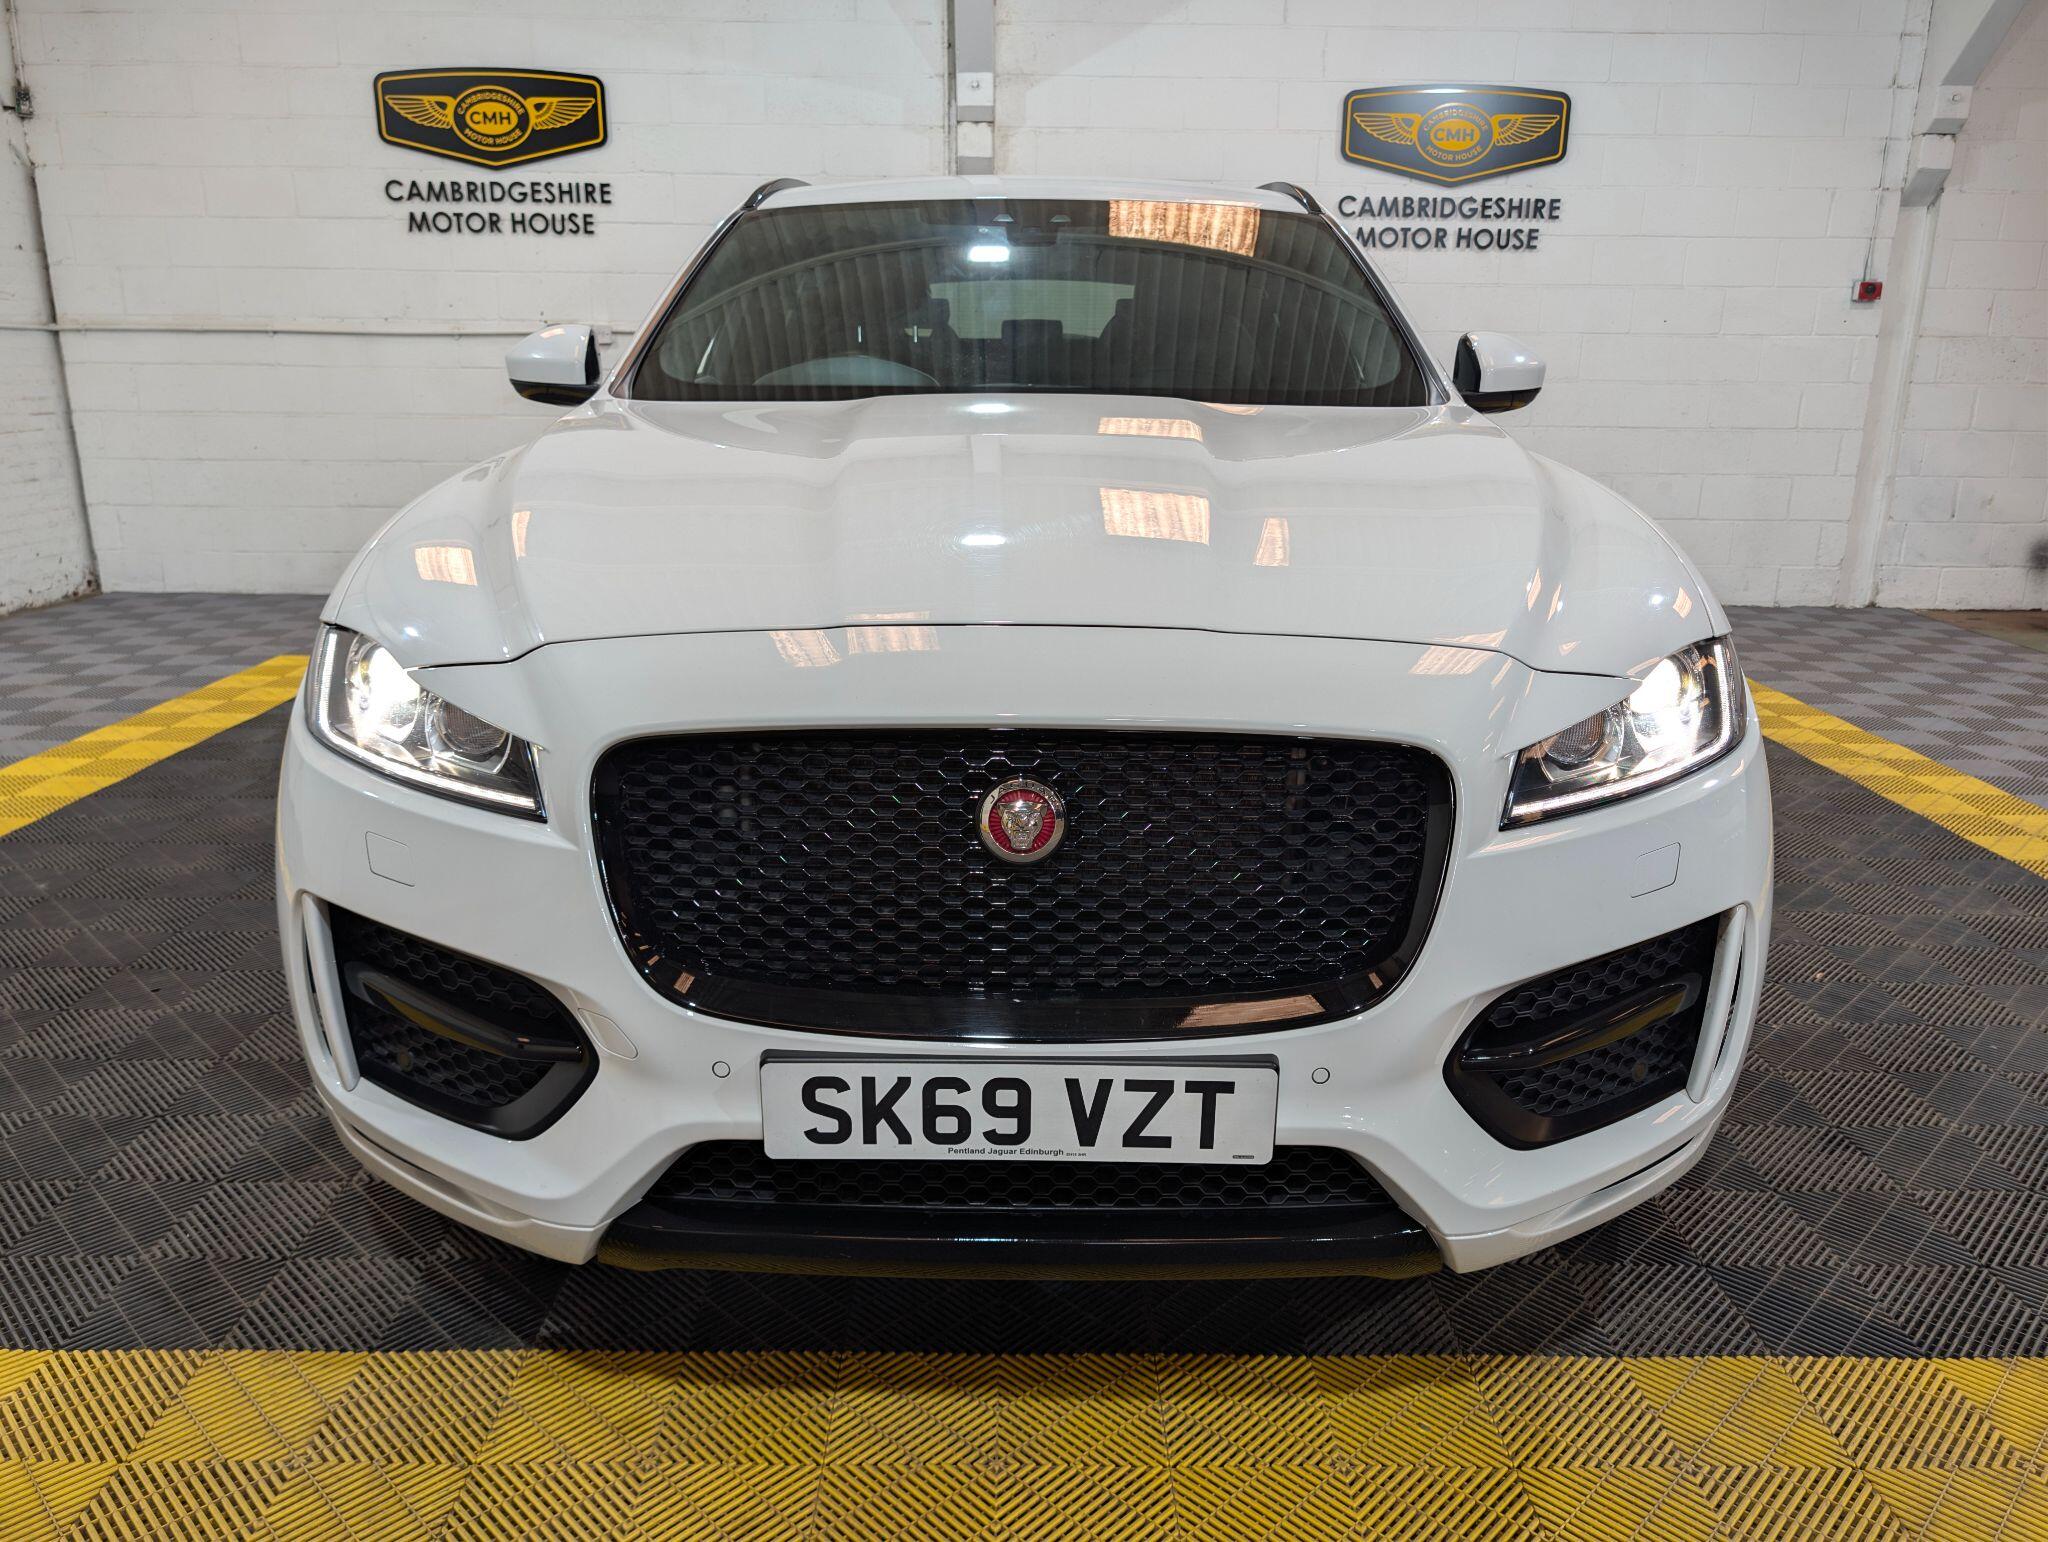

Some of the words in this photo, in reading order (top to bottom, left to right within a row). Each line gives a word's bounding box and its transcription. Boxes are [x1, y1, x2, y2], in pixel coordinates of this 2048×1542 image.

[470, 111, 511, 125] CMH
[464, 128, 494, 145] MOTOR
[495, 128, 522, 144] HOUSE
[1433, 127, 1475, 142] CMH
[1426, 145, 1453, 161] MOTOR
[1455, 145, 1482, 161] HOUSE
[385, 179, 612, 204] CAMBRIDGESHIRE
[1338, 195, 1561, 220] CAMBRIDGESHIRE
[408, 211, 502, 233] MOTOR
[511, 212, 595, 235] HOUSE
[1356, 226, 1447, 249] MOTOR
[1456, 227, 1540, 250] HOUSE
[801, 1076, 1032, 1146] SK69
[1064, 1077, 1236, 1150] VZT
[948, 1147, 985, 1155] Pentland
[988, 1147, 1018, 1156] Jaguar
[1020, 1148, 1064, 1157] Edinburgh
